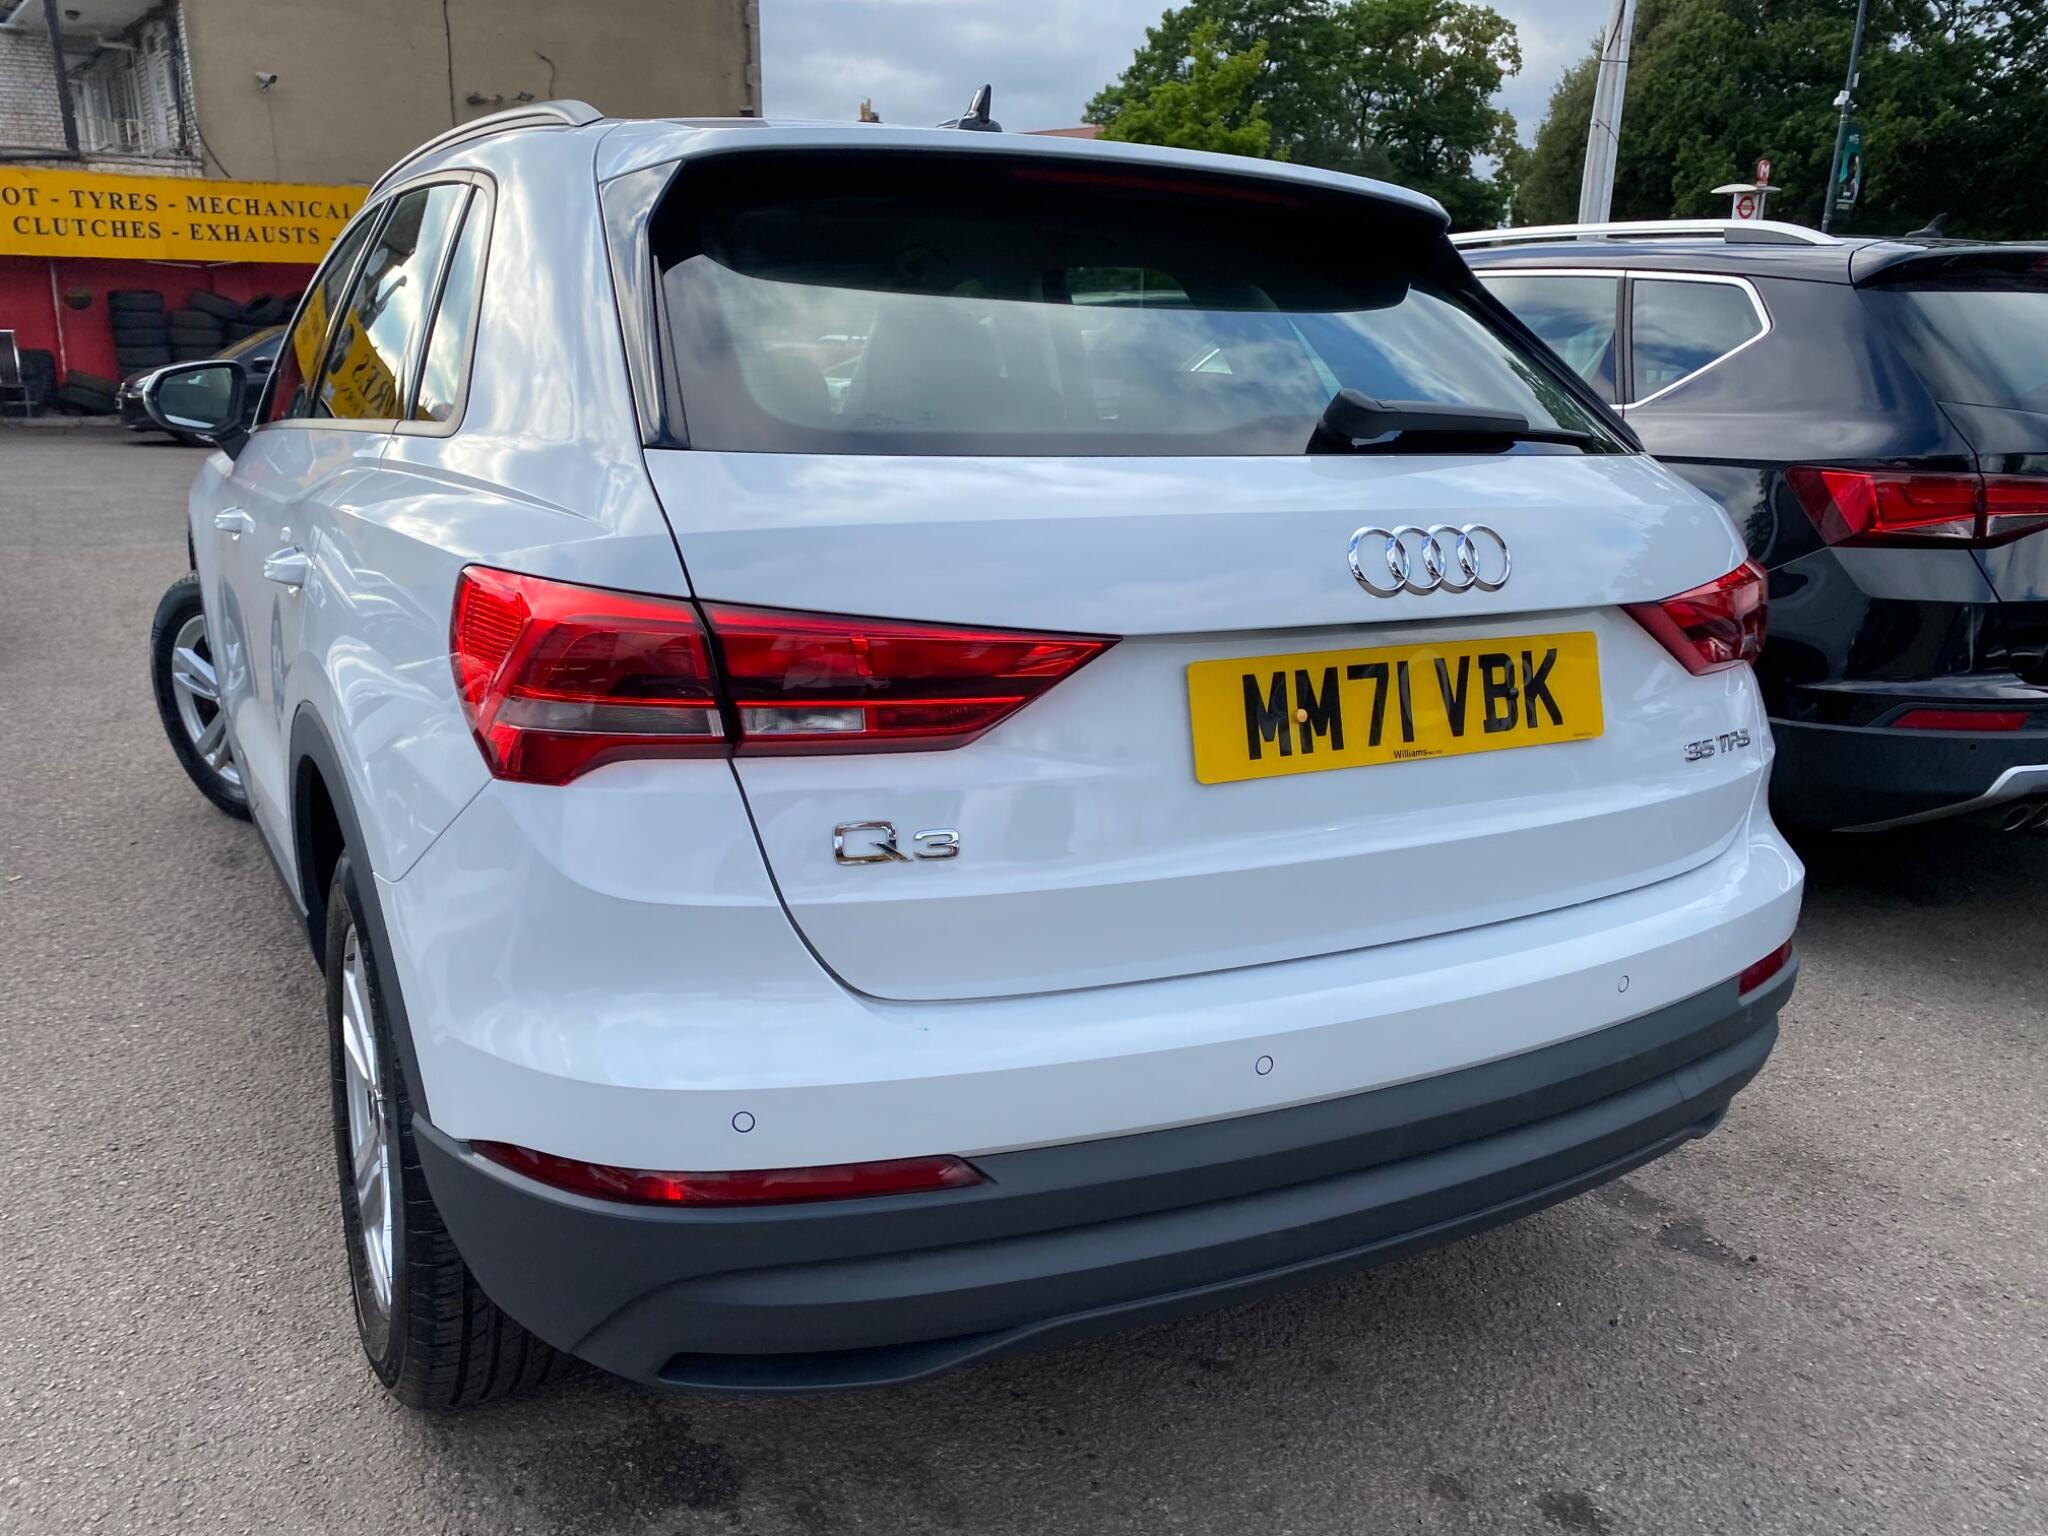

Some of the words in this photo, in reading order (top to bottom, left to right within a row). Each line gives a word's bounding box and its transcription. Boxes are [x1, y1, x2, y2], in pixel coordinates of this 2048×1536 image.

[69, 189, 158, 212] TYRES
[13, 215, 161, 239] CLUTCHES
[190, 223, 320, 244] EXHAUSTS
[1243, 661, 1414, 760] MM71
[1435, 648, 1563, 738] VBK
[1394, 749, 1427, 759] Williams
[1684, 738, 1714, 762] 35
[833, 820, 960, 866] Q3
